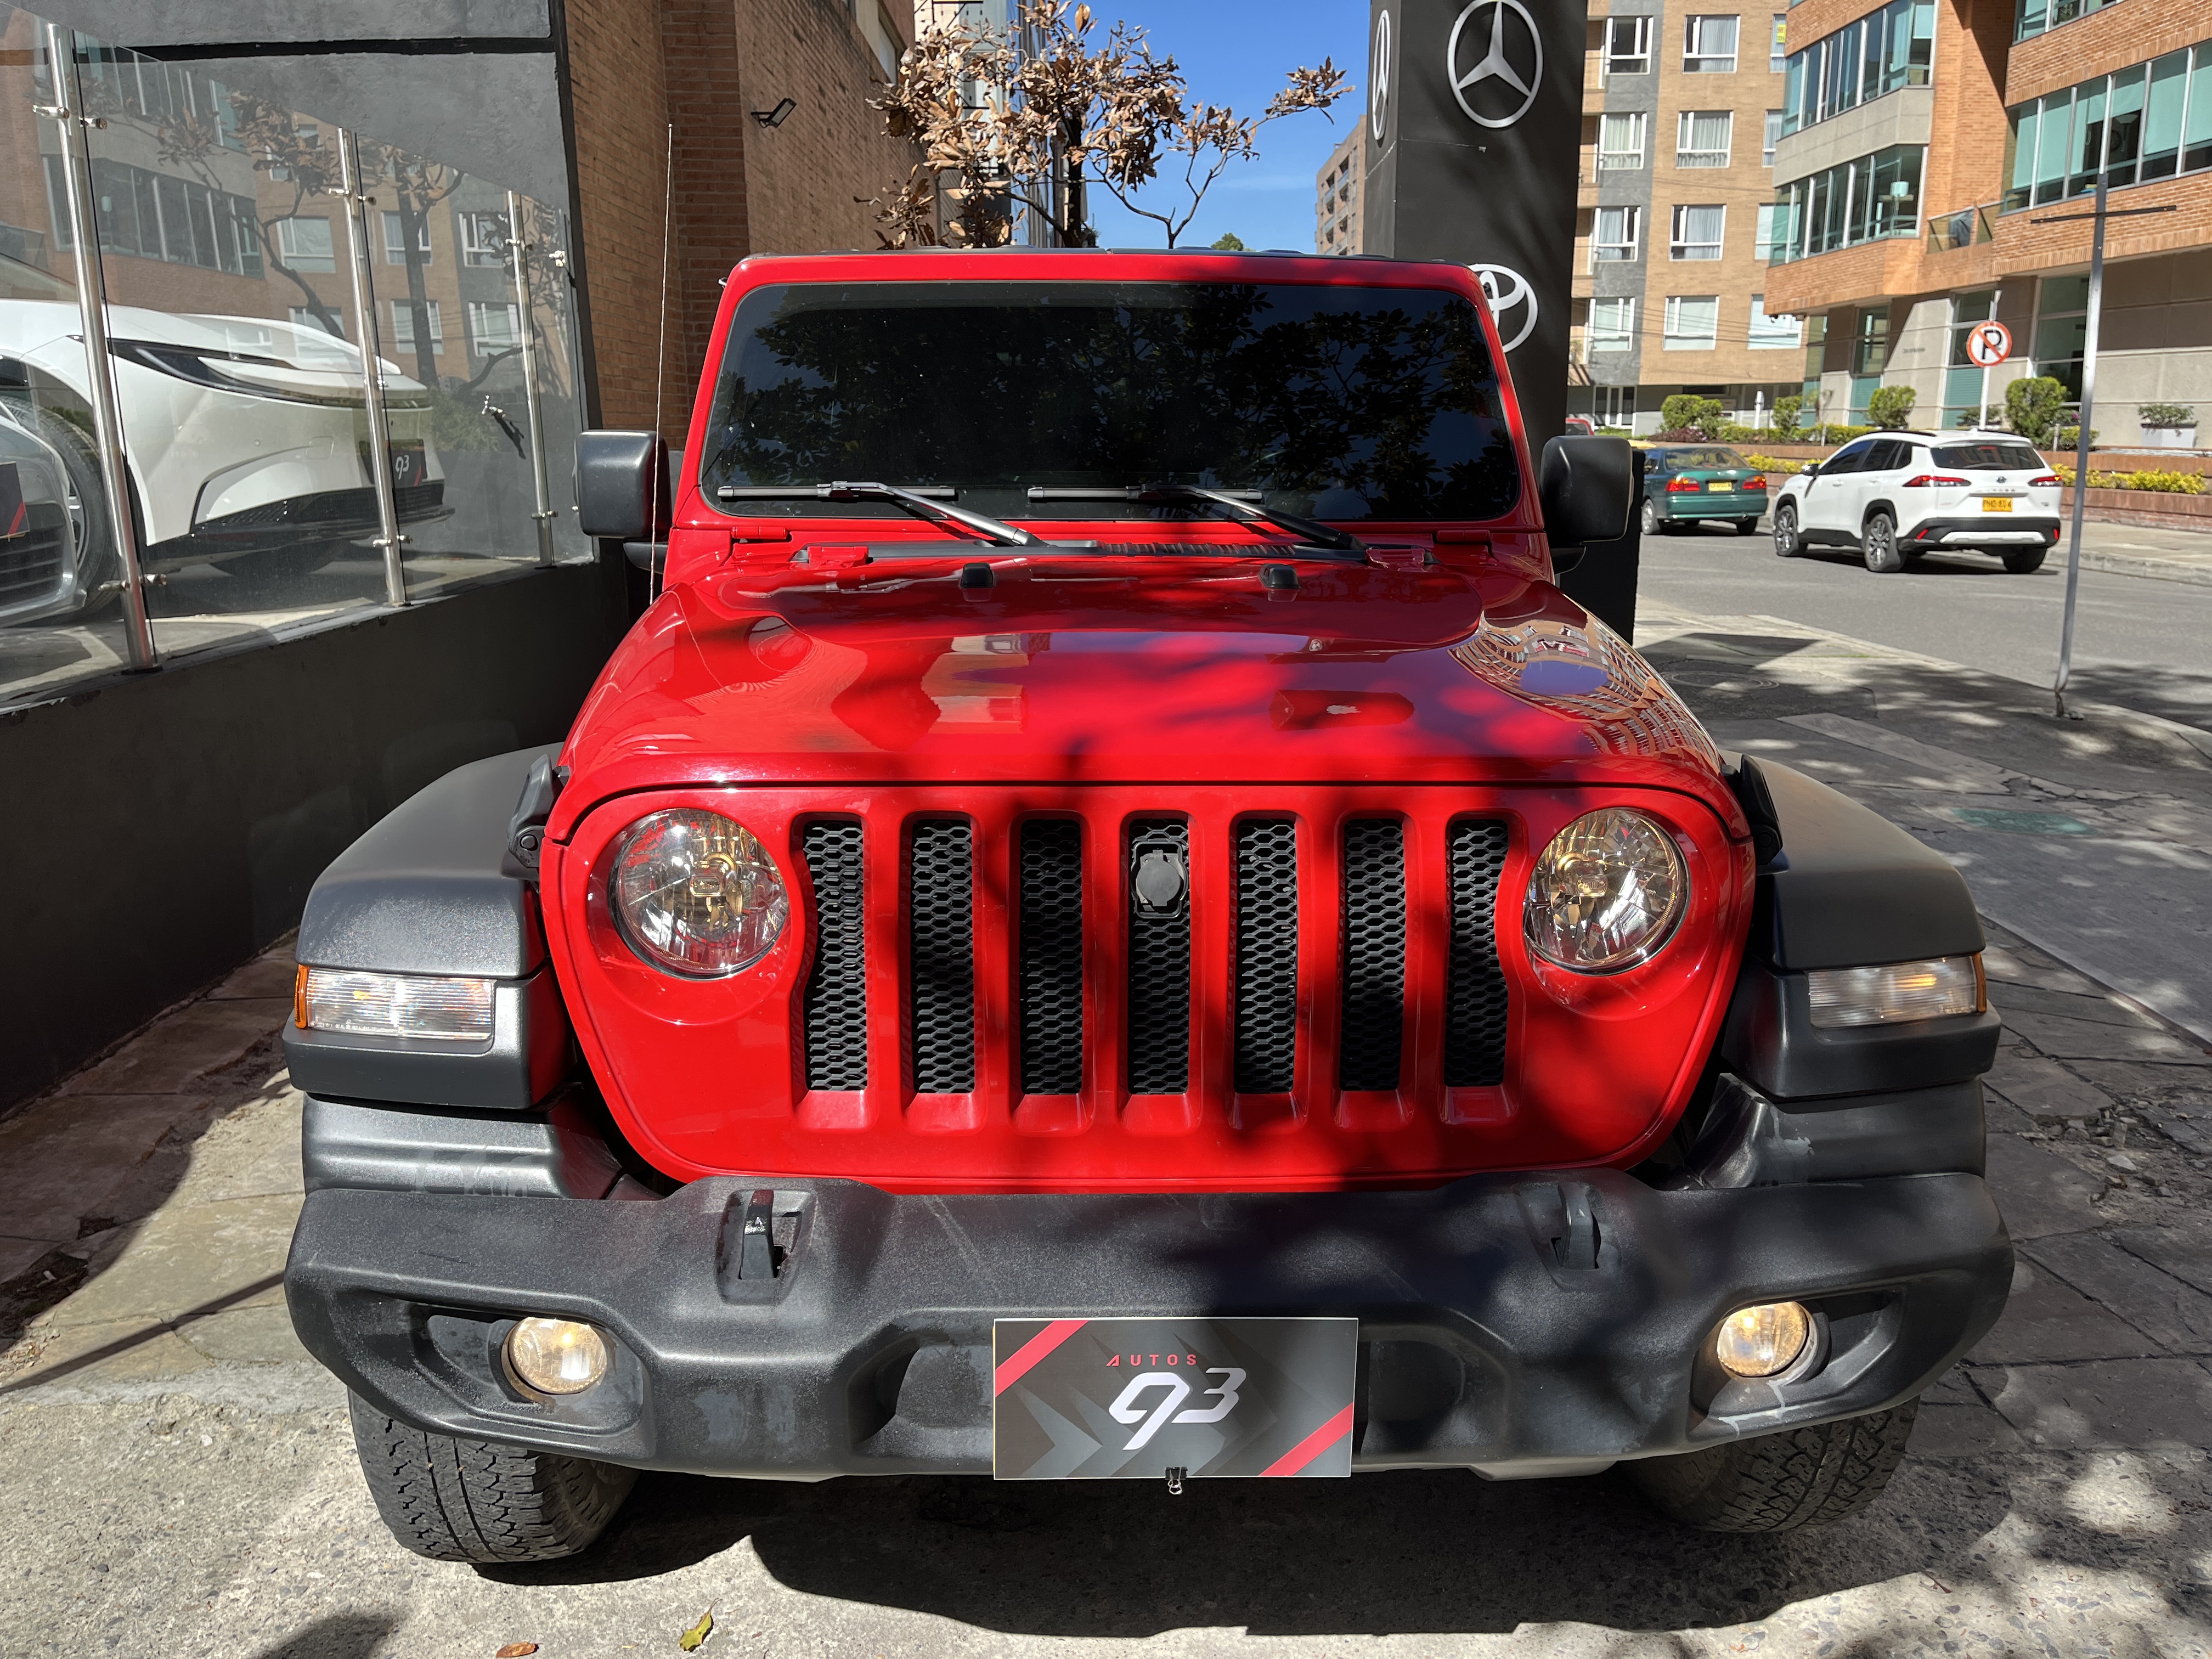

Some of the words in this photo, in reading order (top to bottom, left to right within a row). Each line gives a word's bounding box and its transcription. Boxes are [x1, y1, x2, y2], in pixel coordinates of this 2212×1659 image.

[1982, 330, 2002, 360] P
[395, 454, 410, 480] 93
[1106, 1354, 1197, 1367] AUTOS
[1108, 1367, 1247, 1451] 93
